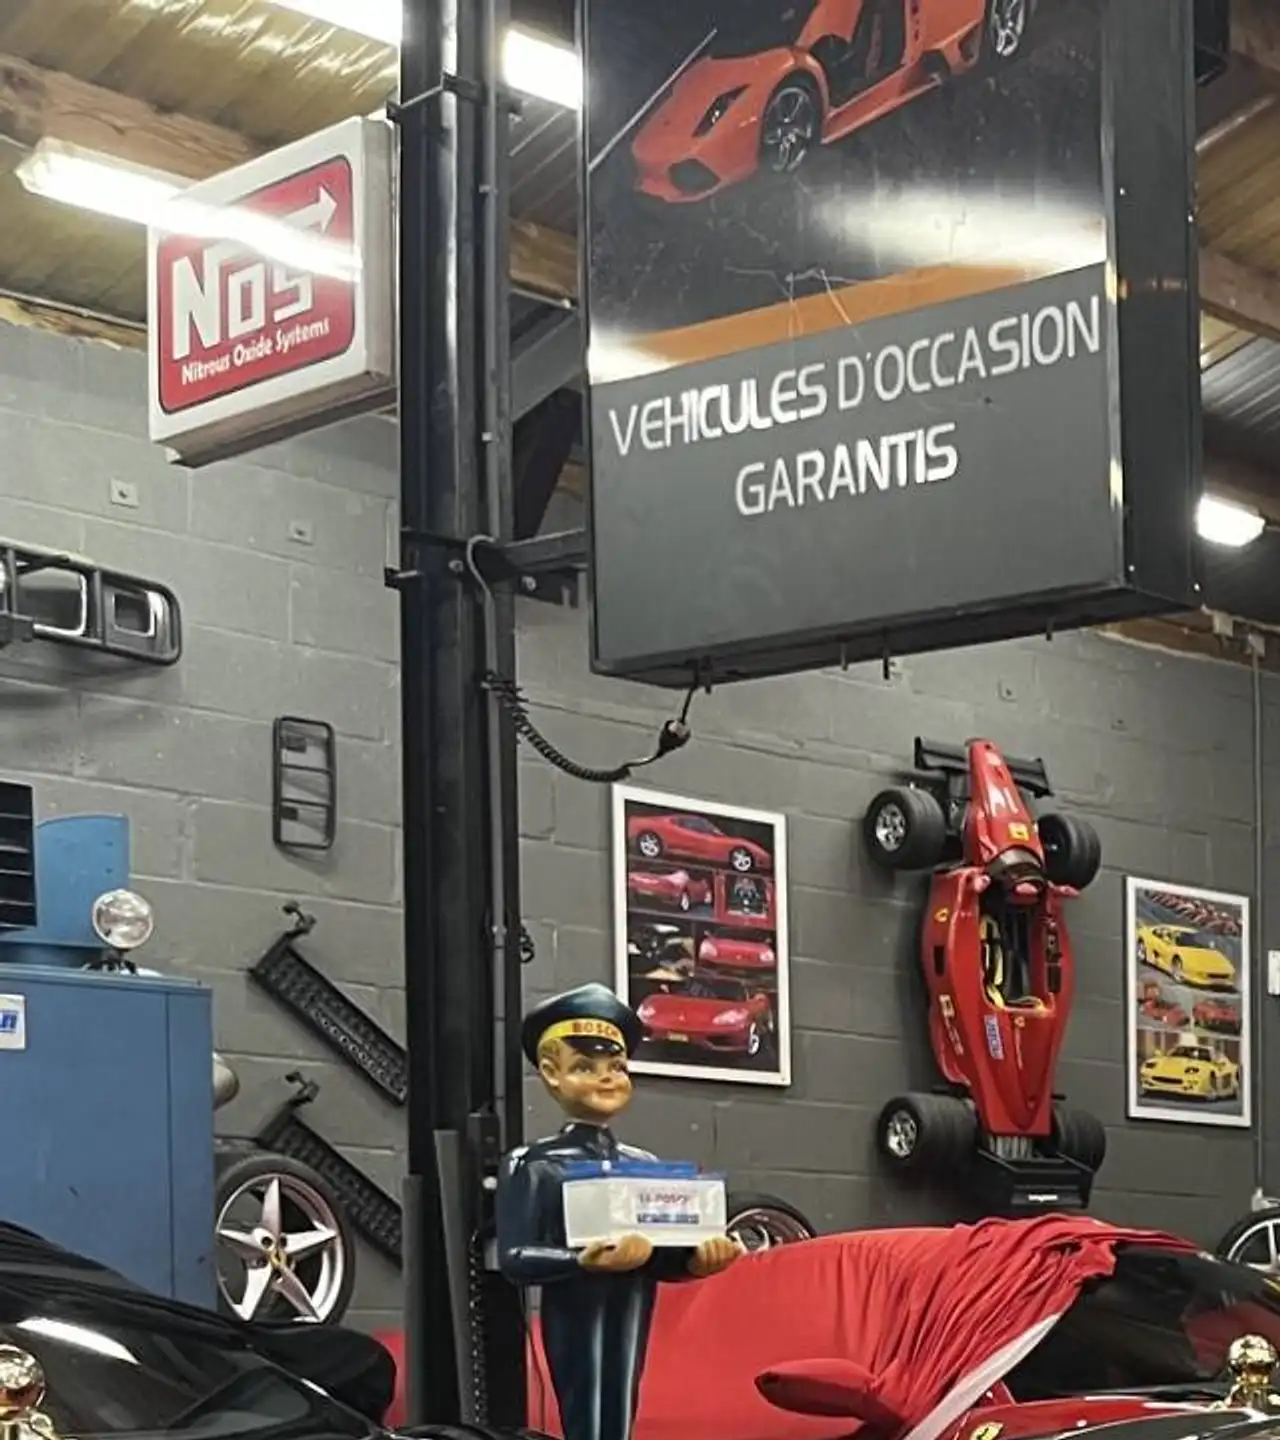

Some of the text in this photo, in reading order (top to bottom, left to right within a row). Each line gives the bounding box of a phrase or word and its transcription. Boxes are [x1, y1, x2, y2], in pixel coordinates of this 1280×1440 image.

[181, 317, 330, 386] Nitrous Oxide Systems
[609, 296, 1100, 456] VEHICULES D'OCCASION
[735, 423, 958, 516] GARANTIS
